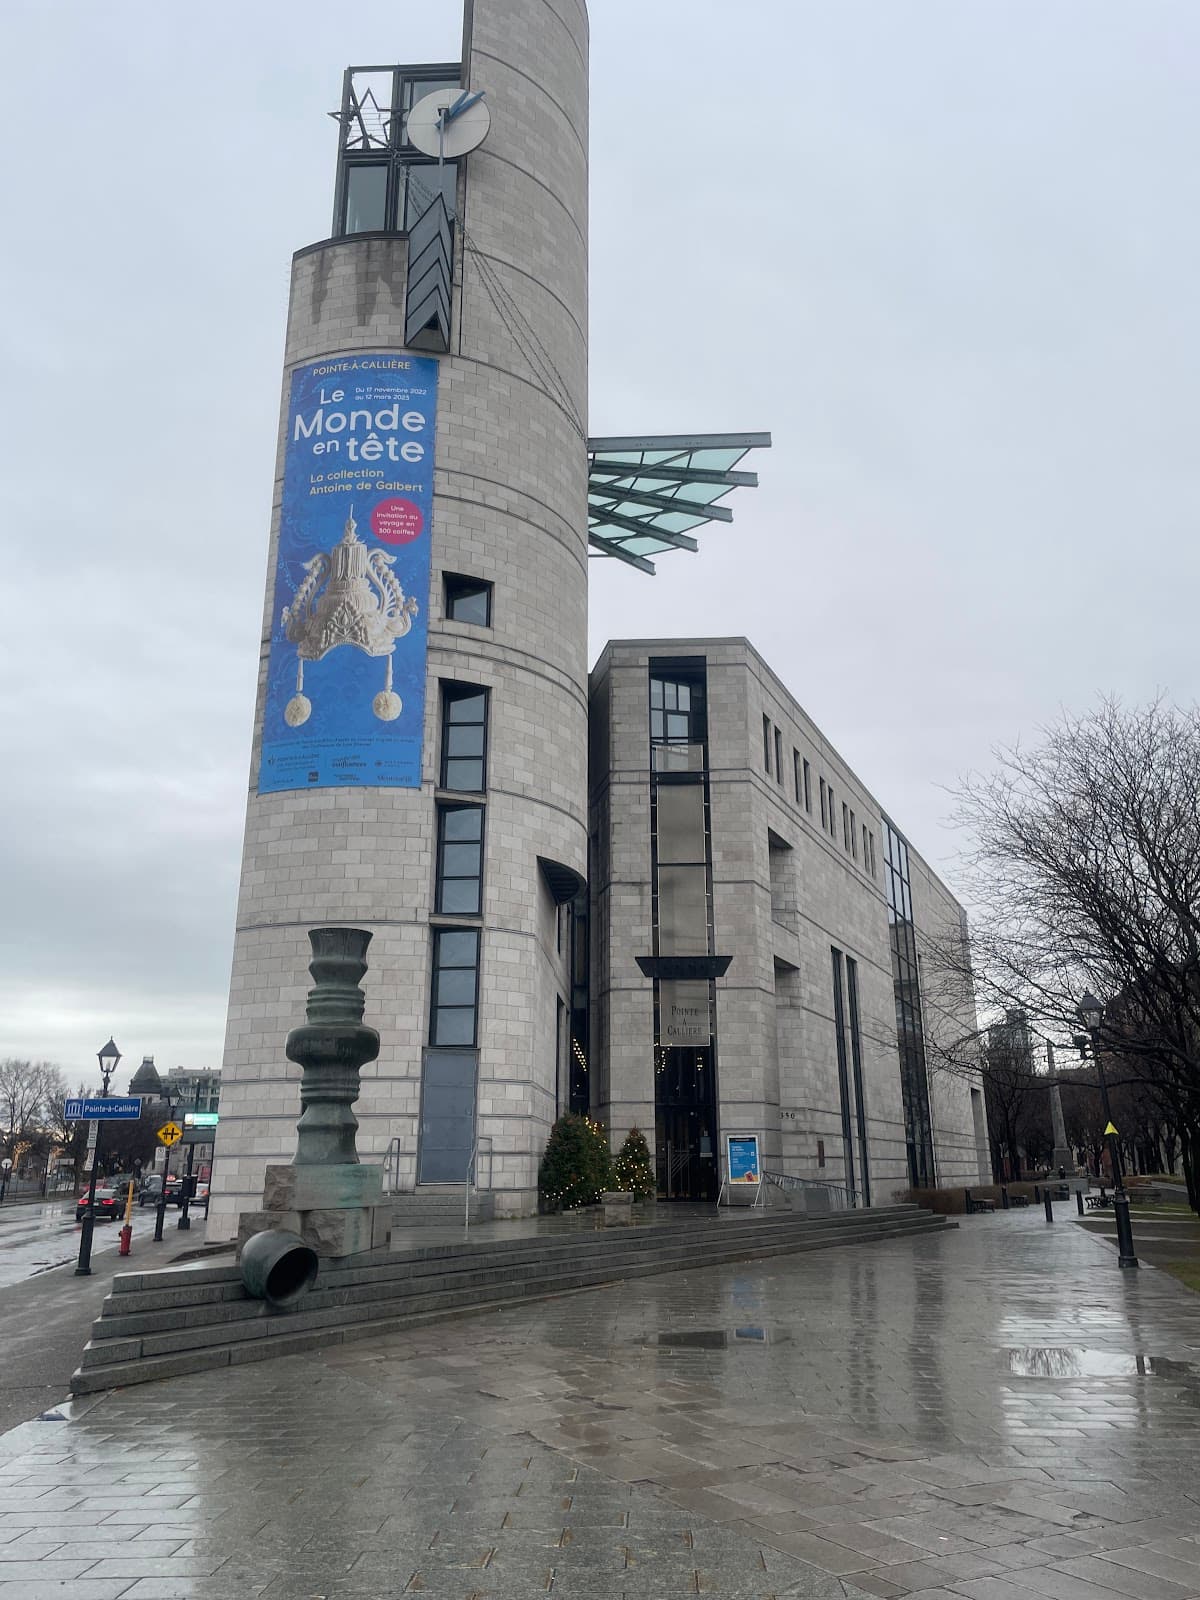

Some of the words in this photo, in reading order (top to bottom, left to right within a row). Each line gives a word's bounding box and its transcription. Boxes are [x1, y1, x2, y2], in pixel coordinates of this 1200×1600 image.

[313, 360, 411, 376] POINTE-À-CALLIÈRE
[320, 389, 345, 404] Le
[294, 403, 426, 441] Monde
[313, 440, 340, 455] en
[346, 432, 425, 463] tête
[310, 474, 324, 484] La
[327, 469, 385, 481] collection
[309, 482, 353, 496] Antoine
[356, 481, 372, 490] de
[376, 480, 424, 493] Galbert
[376, 512, 408, 520] invitation
[392, 528, 415, 536] coiffes
[84, 1104, 139, 1113] Pointe-à-Callière
